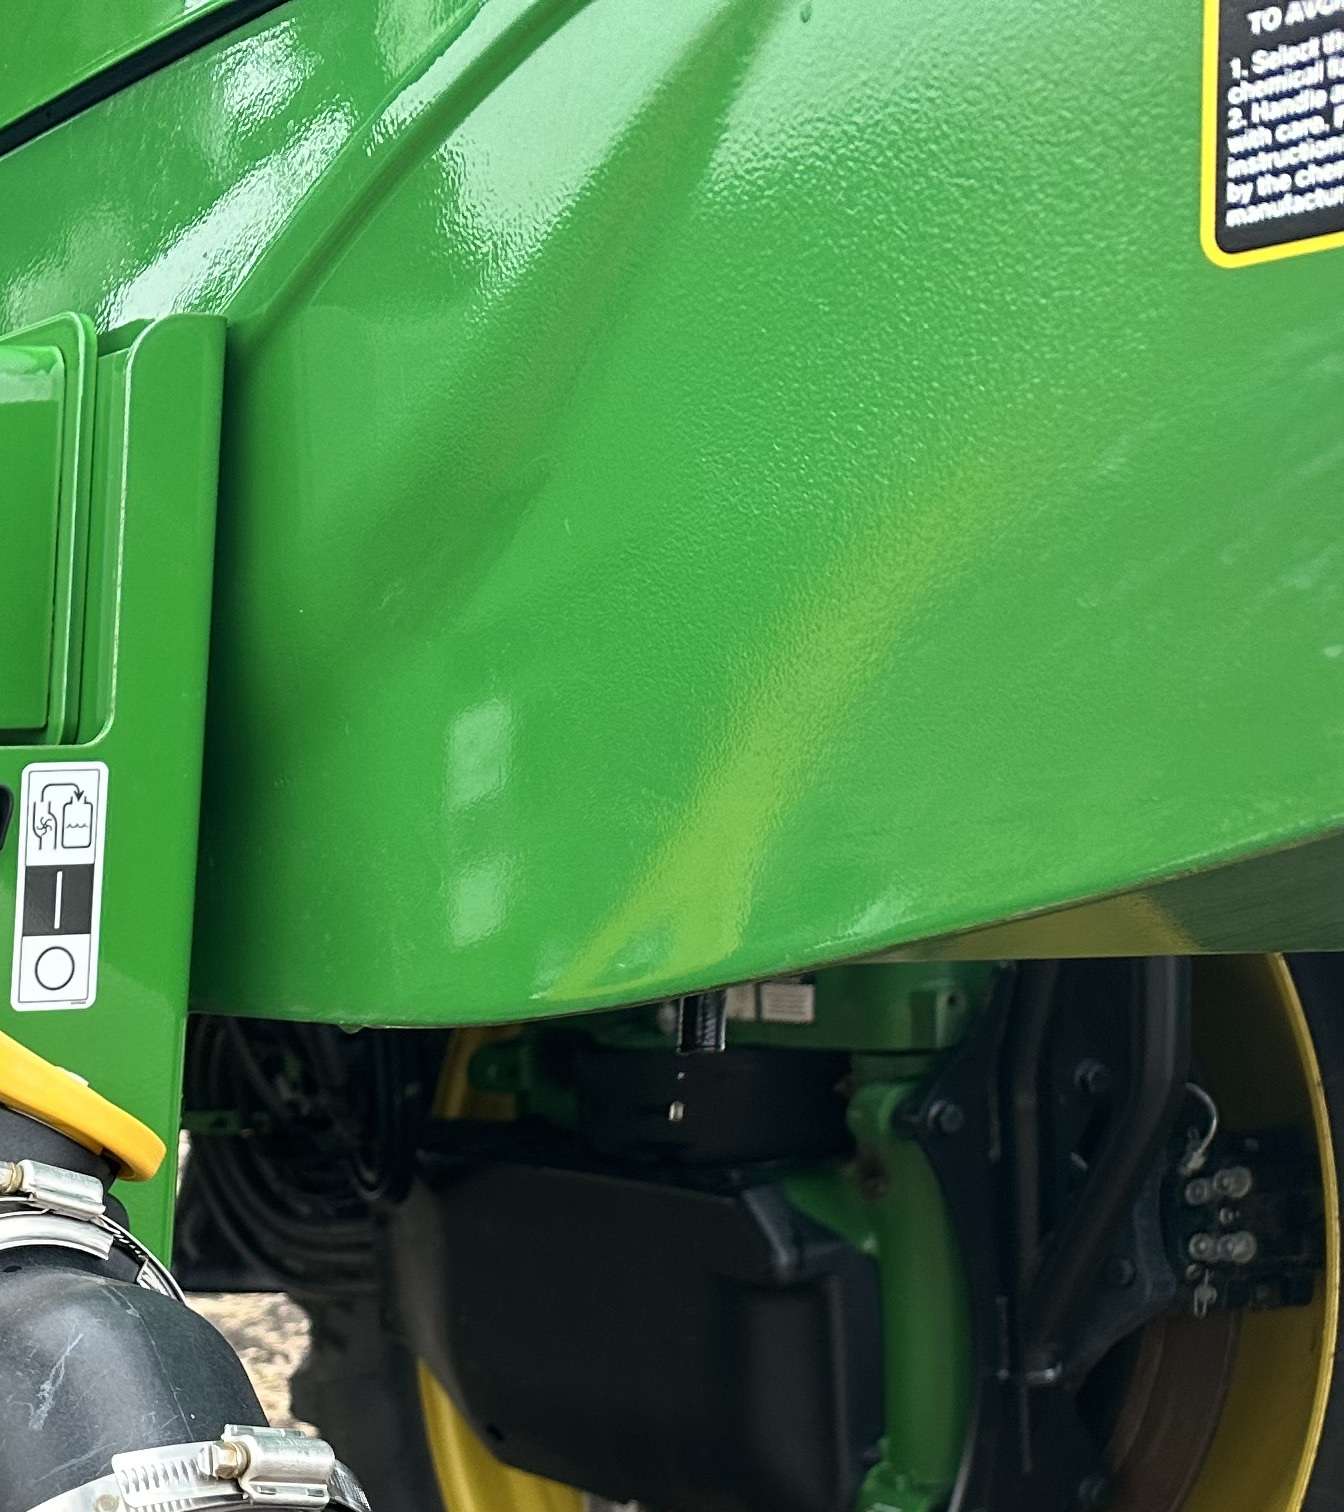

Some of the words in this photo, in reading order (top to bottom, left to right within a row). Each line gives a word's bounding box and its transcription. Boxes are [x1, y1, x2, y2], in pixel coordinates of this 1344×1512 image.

[1246, 6, 1283, 36] TO
[1229, 57, 1249, 80] 1.
[1252, 36, 1320, 74] Select
[1227, 60, 1325, 105] chemical
[1227, 107, 1247, 130] 2.
[1251, 88, 1328, 123] Handle
[1227, 125, 1272, 154] with
[1275, 115, 1330, 143] care.
[1226, 181, 1253, 205] by
[1256, 173, 1293, 198] the
